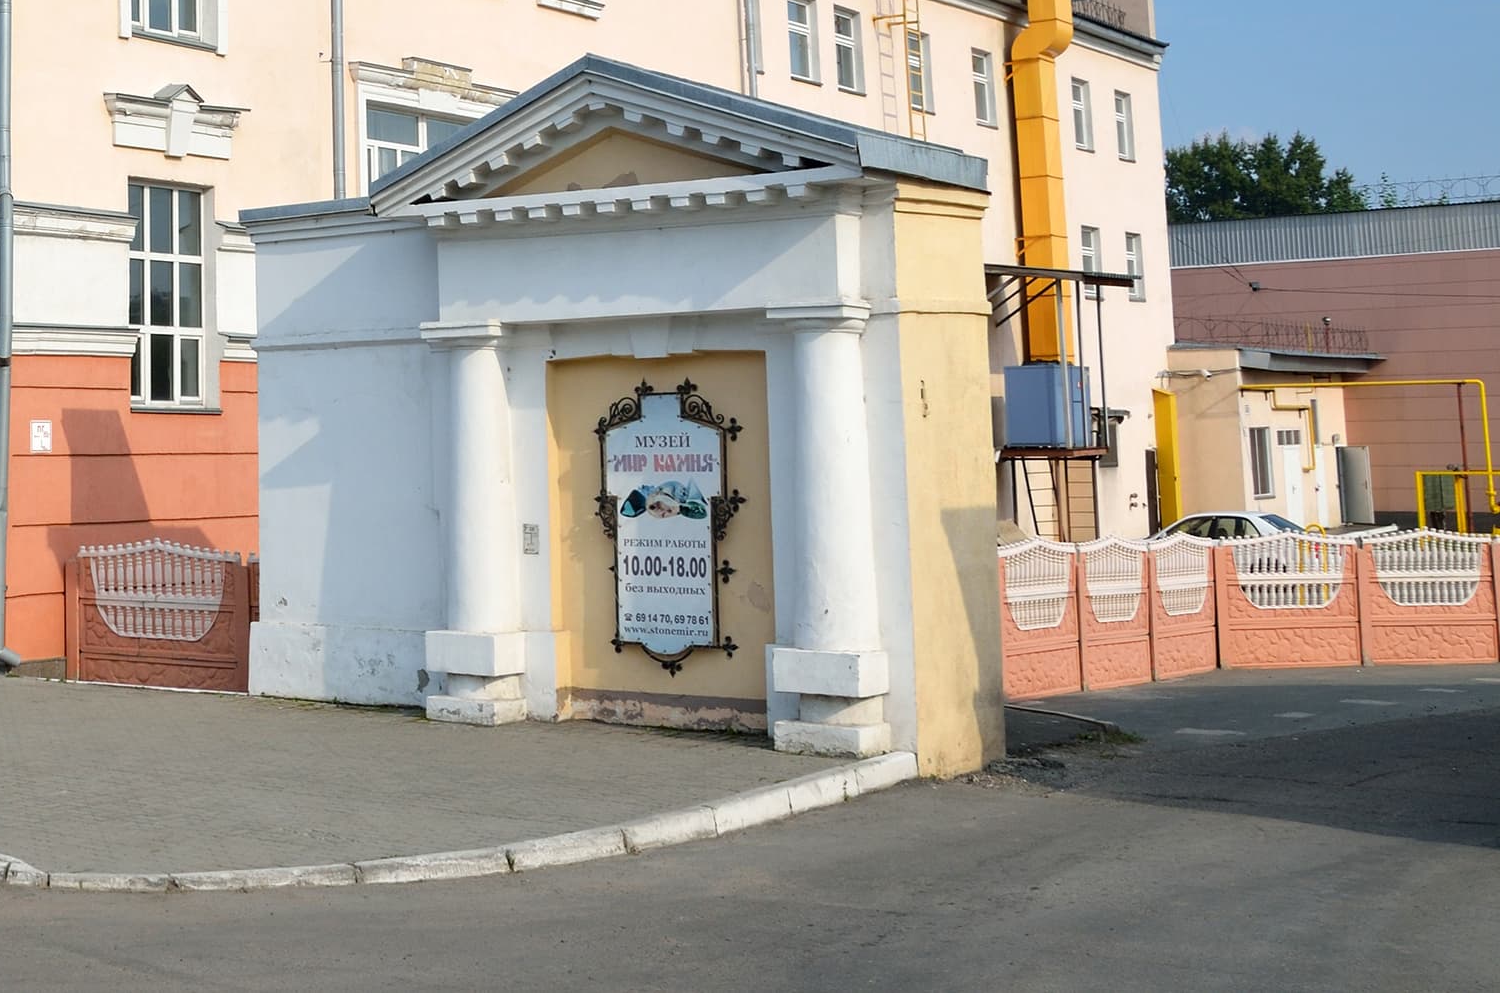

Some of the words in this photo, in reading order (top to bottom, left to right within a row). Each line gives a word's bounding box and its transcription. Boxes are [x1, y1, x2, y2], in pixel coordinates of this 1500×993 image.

[635, 432, 691, 448] МУЗЕЙ
[613, 453, 648, 473] МИР
[653, 453, 714, 473] КАМНЯ
[623, 538, 663, 548] РЕЖИМ
[665, 539, 706, 549] РАБОТЫ
[623, 555, 707, 578] 10.00-18.00
[625, 582, 644, 593] без
[646, 586, 706, 596] выходных
[635, 613, 646, 623] 69
[648, 614, 658, 623] 14
[660, 614, 673, 625] 70,
[674, 615, 685, 624] 69
[686, 615, 698, 625] 78
[698, 616, 709, 625] 61
[624, 626, 709, 637] www.stonemir.ru
